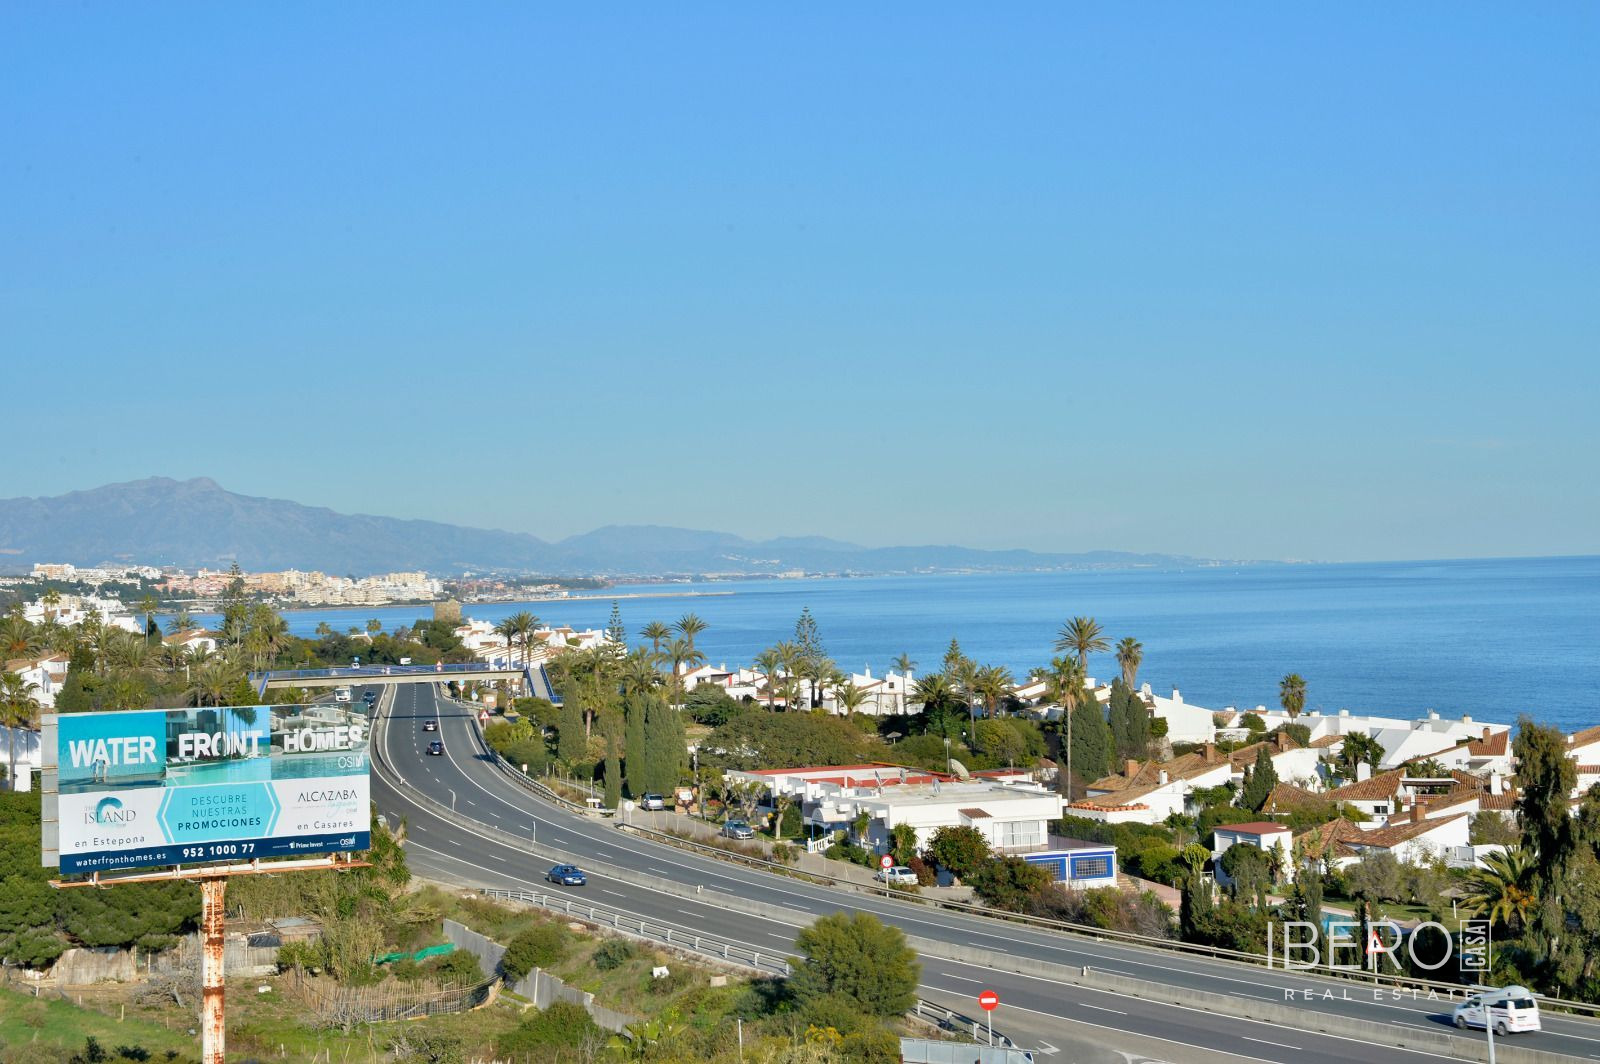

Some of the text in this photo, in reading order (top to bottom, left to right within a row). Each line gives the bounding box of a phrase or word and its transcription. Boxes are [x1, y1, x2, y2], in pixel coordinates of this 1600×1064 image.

[178, 731, 263, 758] FRONT
[284, 725, 362, 753] HOMES
[69, 736, 157, 768] WATER
[191, 794, 247, 806] DESCUBRE
[297, 789, 358, 802] ALCAZABA
[84, 810, 137, 825] ISLAND
[192, 806, 247, 818] NUESTRAS
[178, 817, 261, 831] PROMOCIONES
[313, 820, 353, 829] Casares
[75, 835, 145, 848] en Estepona
[183, 843, 255, 858] 952 1000 77
[76, 853, 167, 867] waterfronthomes.es
